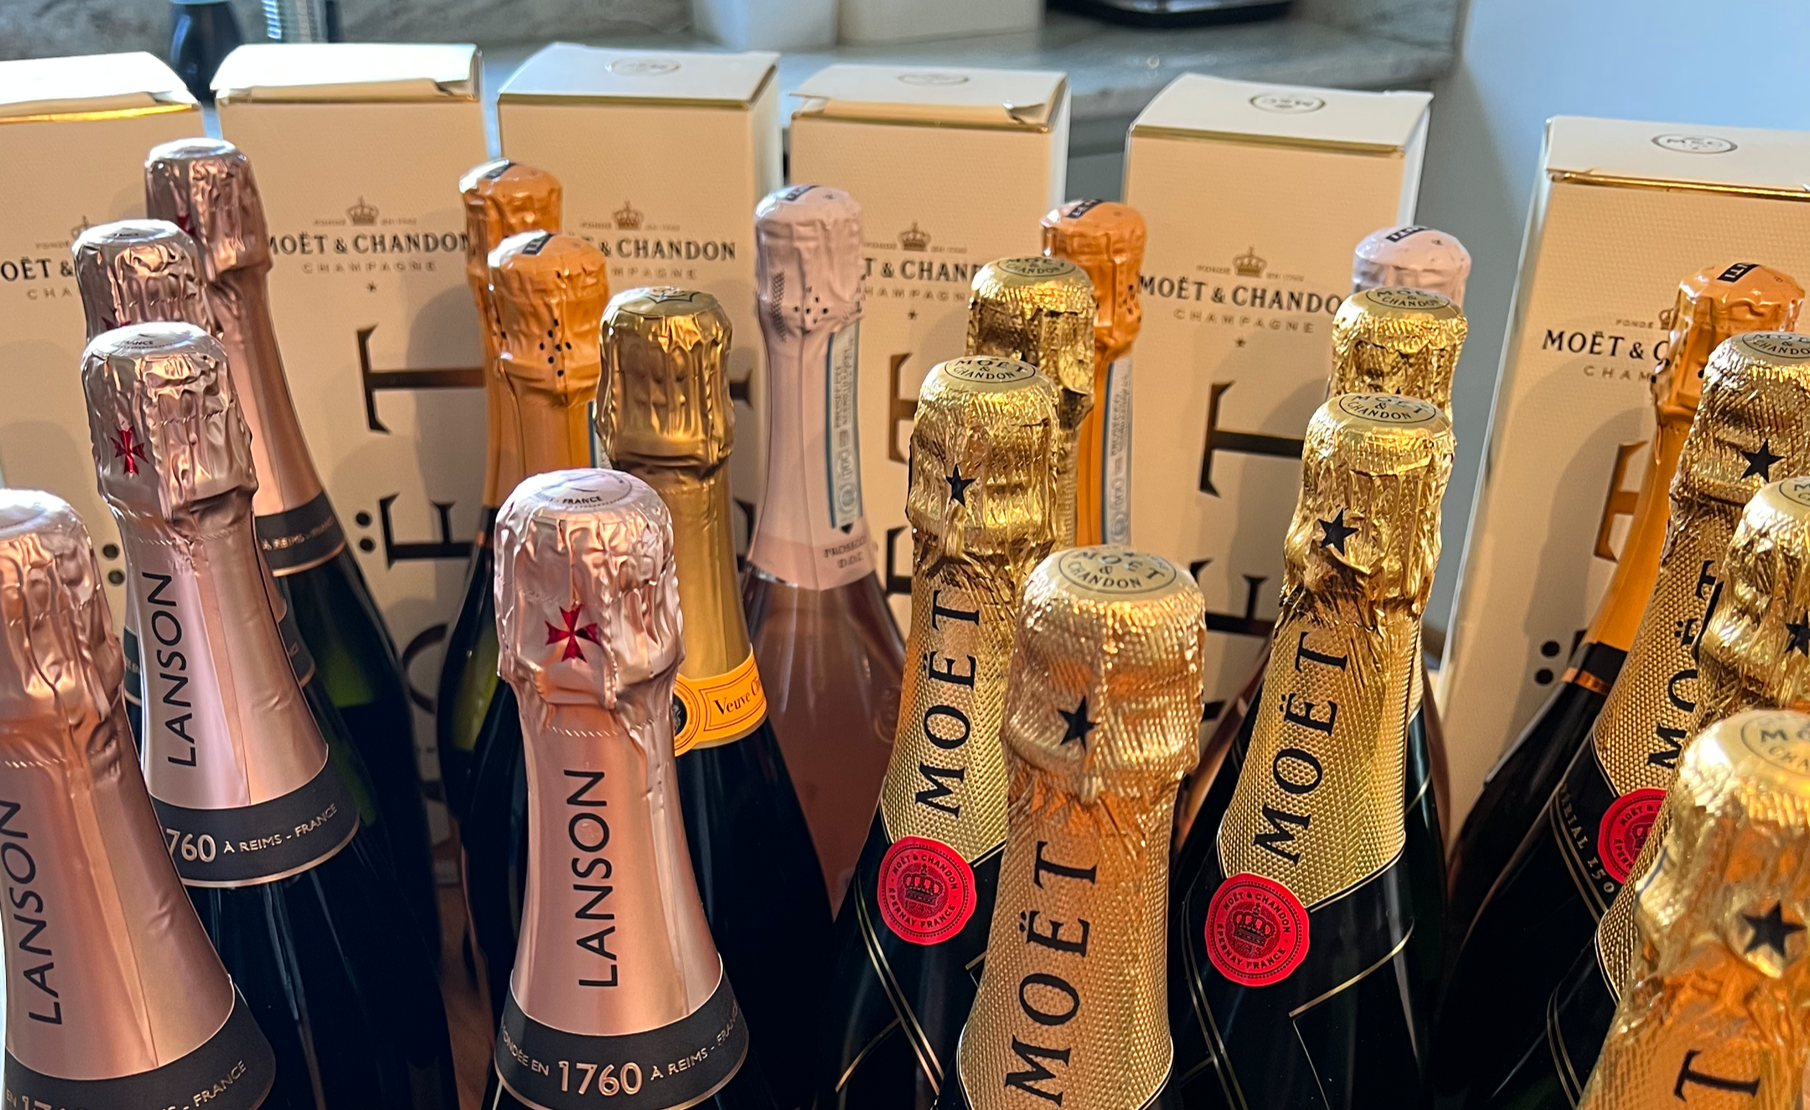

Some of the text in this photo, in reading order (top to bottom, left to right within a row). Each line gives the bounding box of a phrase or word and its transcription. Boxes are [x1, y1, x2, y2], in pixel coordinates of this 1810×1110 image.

[335, 238, 348, 254] &
[616, 238, 736, 260] CHANDON
[0, 257, 52, 282] OËT
[611, 267, 697, 280] MPAGNE
[880, 261, 895, 278] &
[1138, 274, 1346, 316] MOËT & CHANDO
[1173, 308, 1316, 334] CHAMPAGNE
[1542, 329, 1626, 356] MOËT
[1628, 341, 1645, 360] &
[953, 366, 1016, 380] CHANDON
[1347, 400, 1412, 420] CHANDON
[1374, 402, 1388, 411] &
[562, 494, 603, 506] FRANCE
[1067, 561, 1143, 589] CHANDON
[1099, 565, 1113, 576] &
[141, 571, 198, 768] LANSON
[713, 692, 751, 716] Veuve
[914, 590, 981, 819] MOËT
[1253, 631, 1349, 867] MOËT
[166, 828, 217, 863] 760
[223, 840, 235, 854] À
[239, 834, 283, 853] REIMS
[294, 803, 338, 838] FRANCE
[563, 768, 619, 988] LANSON
[921, 854, 959, 890] CHANDON
[1587, 856, 1615, 894] 150
[0, 800, 63, 1026] LANSON
[920, 903, 956, 928] FRANCE
[1255, 893, 1292, 934] CHANDON
[1246, 947, 1286, 970] FRANCE
[1004, 840, 1098, 1108] MOËT
[503, 1027, 530, 1067] ONDÉE
[531, 1059, 550, 1077] EN
[557, 1060, 643, 1097] 1760
[650, 1065, 664, 1081] À
[667, 1047, 709, 1076] REIMS
[192, 1060, 248, 1108] FRANCE
